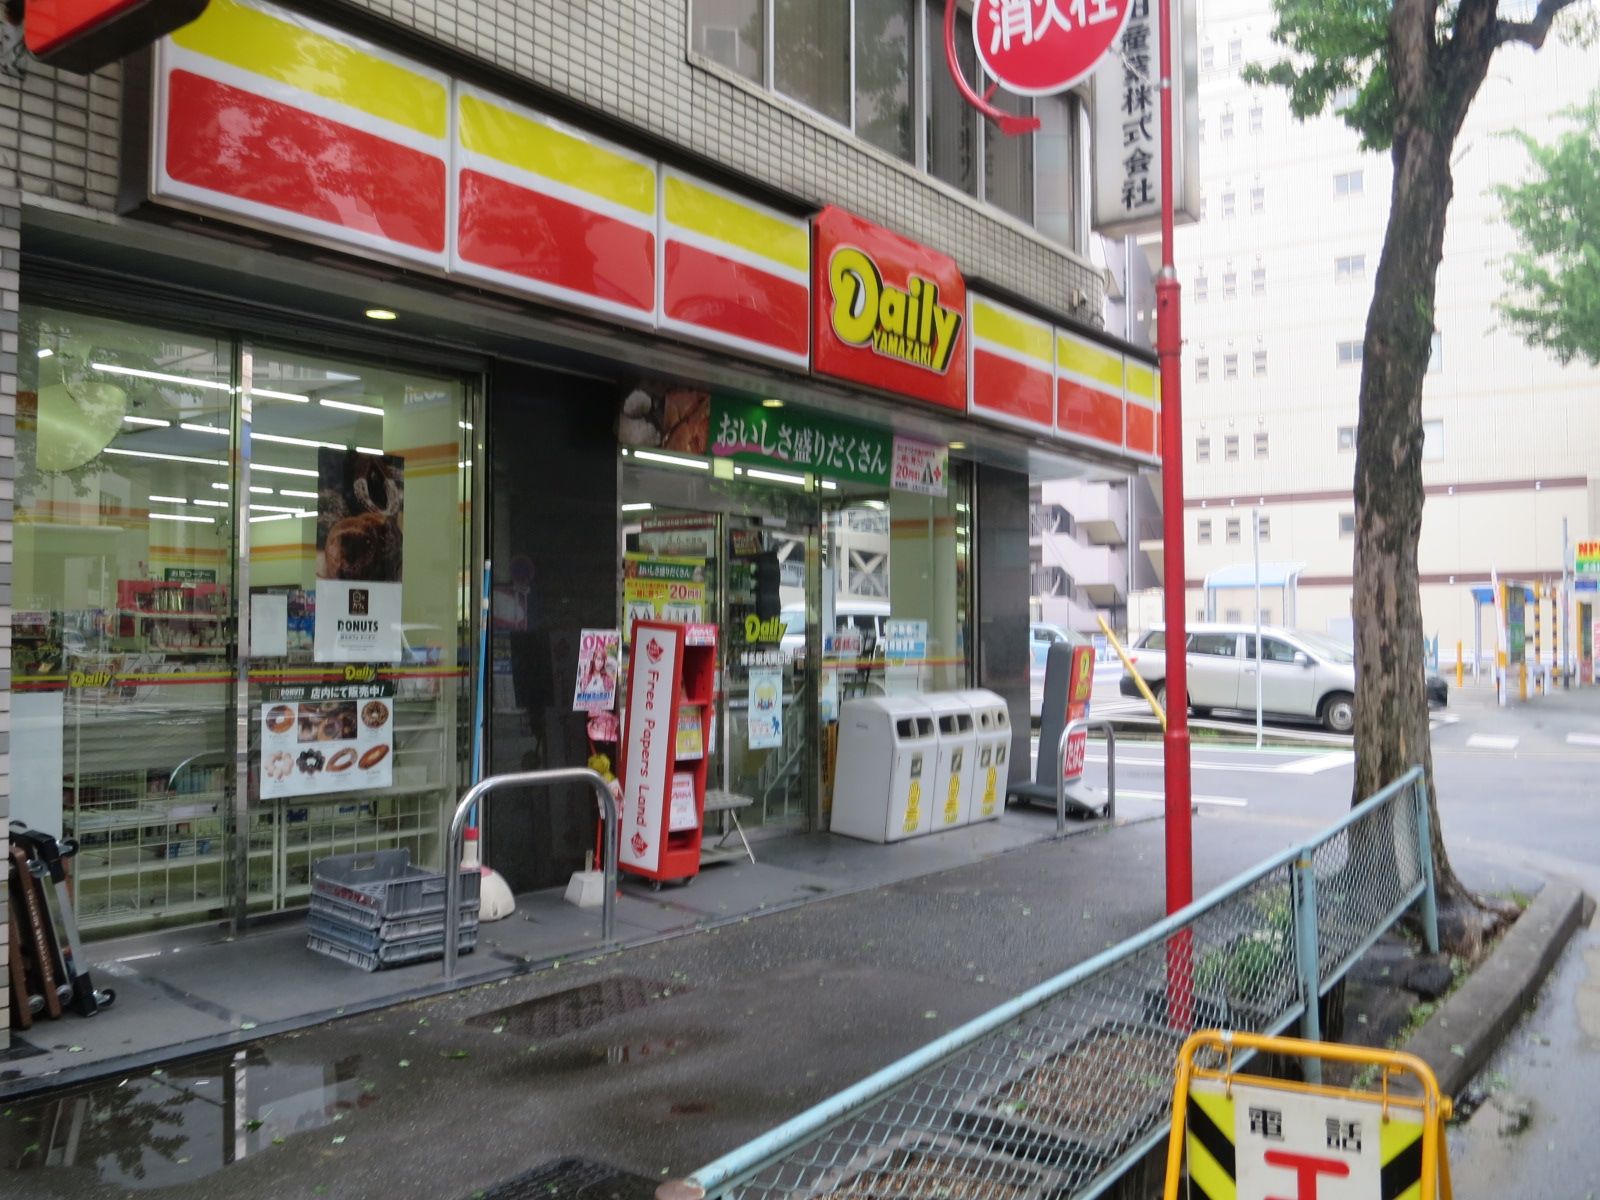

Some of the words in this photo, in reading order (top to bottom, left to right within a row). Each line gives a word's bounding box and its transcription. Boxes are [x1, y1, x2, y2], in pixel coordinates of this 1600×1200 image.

[830, 247, 962, 372] Daily
[873, 329, 933, 368] YAMAZAKI
[717, 412, 887, 476] おいしさ盛りだくさん
[337, 619, 379, 632] DONUTS
[745, 613, 788, 643] Daily
[70, 671, 112, 688] Daily
[345, 665, 376, 681] Daily
[645, 669, 660, 711] Free
[639, 718, 656, 777] Papers
[636, 784, 650, 827] Land
[1249, 1105, 1362, 1154] 電話
